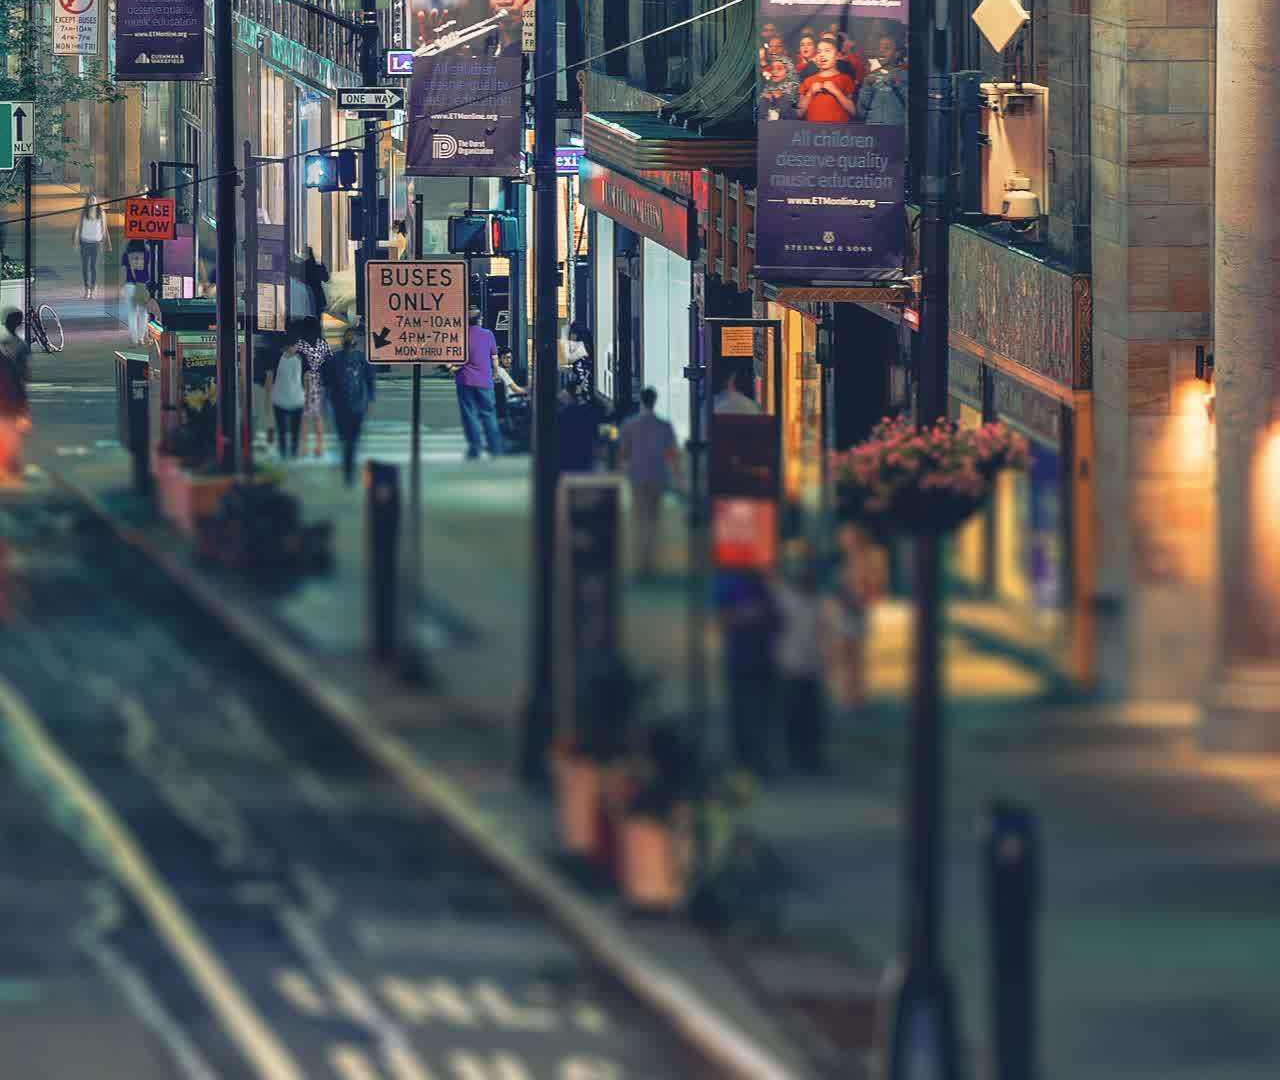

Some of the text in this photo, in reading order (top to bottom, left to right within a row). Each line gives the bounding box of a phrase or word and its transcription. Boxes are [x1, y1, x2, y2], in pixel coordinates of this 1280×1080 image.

[55, 16, 97, 25] EXCEPT BUSES
[346, 95, 394, 103] ONE WAY
[431, 112, 498, 121] www.ETMonline.org
[791, 130, 874, 148] All children
[775, 152, 889, 171] deserve quality
[770, 171, 896, 189] music education
[787, 196, 876, 209] www.ETMonline.org
[130, 204, 169, 217] RAISE
[129, 220, 169, 233] PLOW
[784, 244, 834, 252] STEINWAY
[381, 268, 452, 287] BUSES
[388, 292, 444, 311] ONLY
[396, 315, 462, 328] 7AM-10AM
[399, 331, 458, 343] 4PM-7PM
[395, 346, 462, 356] MON THRU FRI
